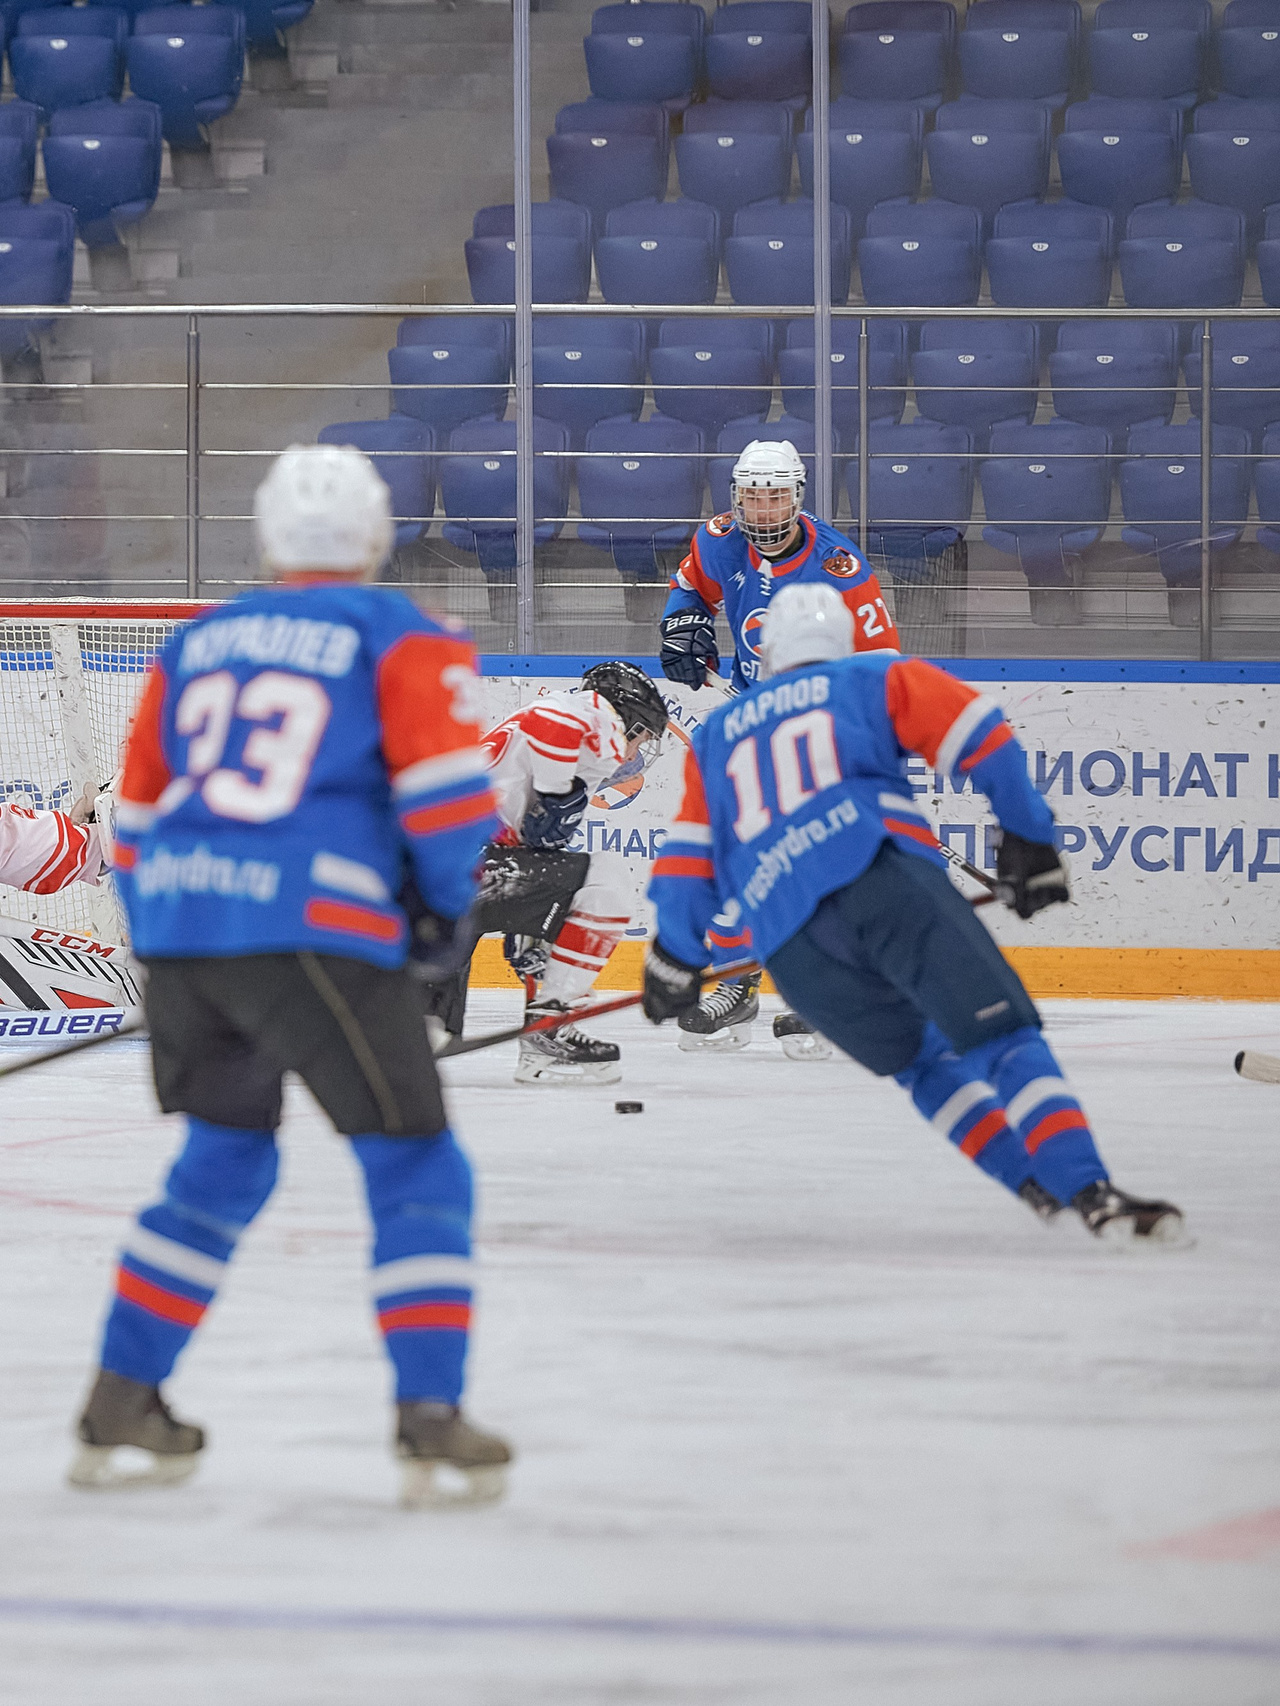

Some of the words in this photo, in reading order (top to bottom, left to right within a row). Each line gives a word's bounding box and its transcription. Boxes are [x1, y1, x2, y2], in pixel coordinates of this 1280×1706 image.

[723, 675, 830, 741] КАРПОВ
[726, 709, 843, 843] 10
[31, 928, 116, 958] CCM
